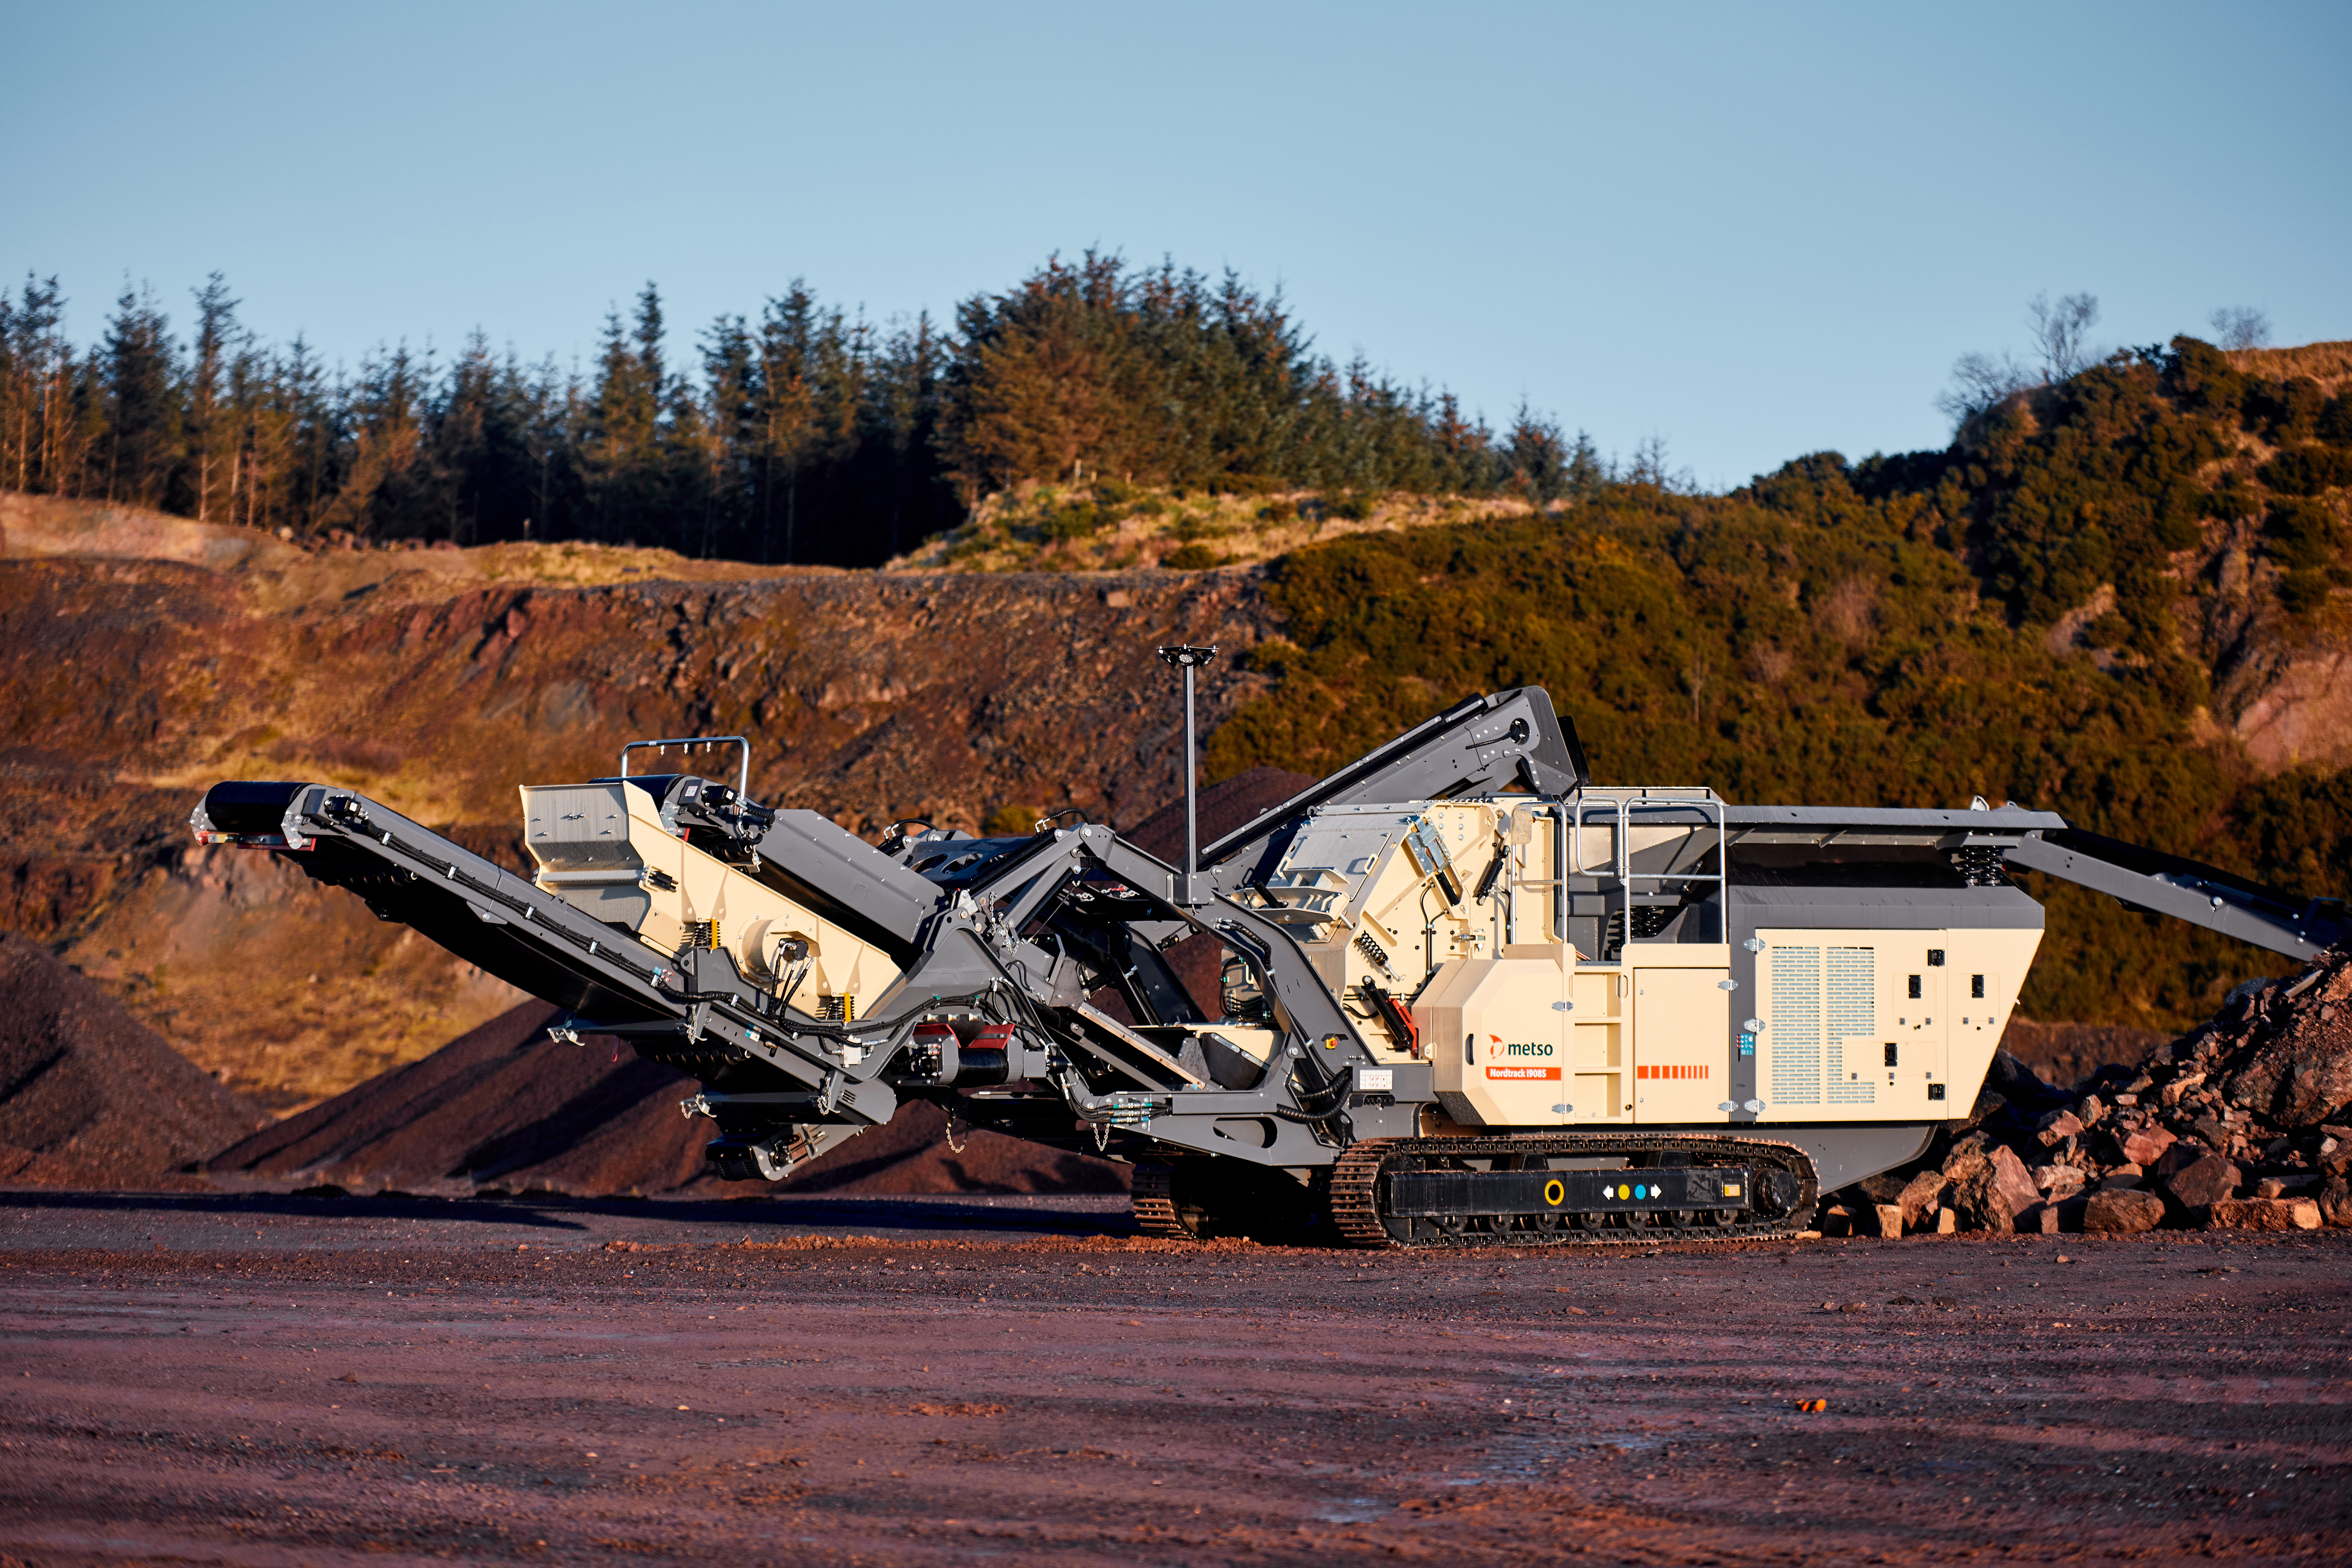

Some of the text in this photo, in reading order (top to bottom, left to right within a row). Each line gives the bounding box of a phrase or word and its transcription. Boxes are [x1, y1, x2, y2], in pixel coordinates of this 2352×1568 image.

[1508, 1042, 1553, 1056] metso
[1490, 1068, 1547, 1078] Nordtrack I908S
